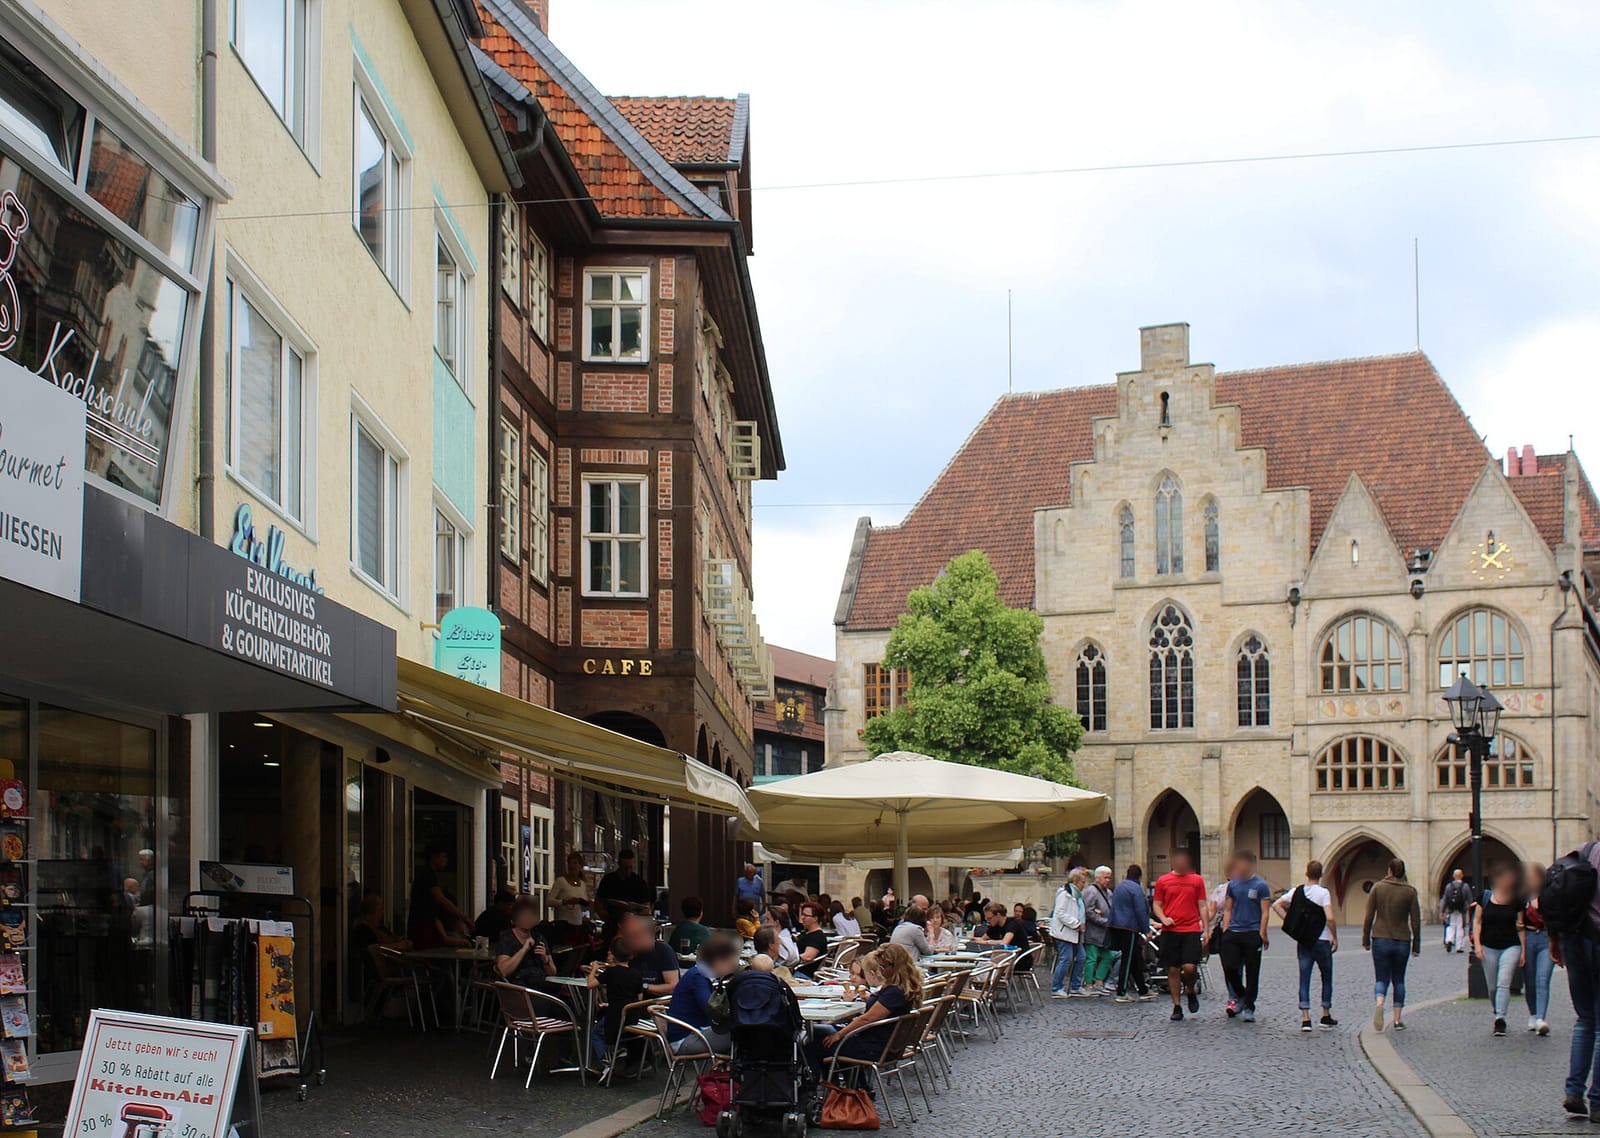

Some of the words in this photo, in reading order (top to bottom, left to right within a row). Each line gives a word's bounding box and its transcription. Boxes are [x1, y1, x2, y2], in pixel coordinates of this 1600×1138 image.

[25, 321, 153, 438] Kochschule
[0, 445, 66, 490] ourmet
[0, 511, 62, 561] IESSEN
[246, 566, 316, 621] EXKLUSIVES
[225, 588, 331, 657] KÜCHENZUBEHÖR
[446, 624, 495, 641] Bistro
[222, 624, 234, 650] &
[236, 632, 334, 687] GOURMETARTIKEL
[457, 653, 487, 670] Eis-
[583, 658, 653, 676] CAFE
[105, 1037, 132, 1052] Jetzt
[135, 1043, 162, 1057] geben
[191, 1049, 218, 1063] euch!
[101, 1061, 116, 1075] 30
[120, 1063, 131, 1077] %
[135, 1065, 170, 1082] Rabatt
[173, 1071, 193, 1085] auf
[196, 1074, 214, 1088] alle
[90, 1078, 214, 1105] KitchenAid
[81, 1117, 97, 1133] 30
[99, 1113, 113, 1127] %
[181, 1123, 198, 1138] 30
